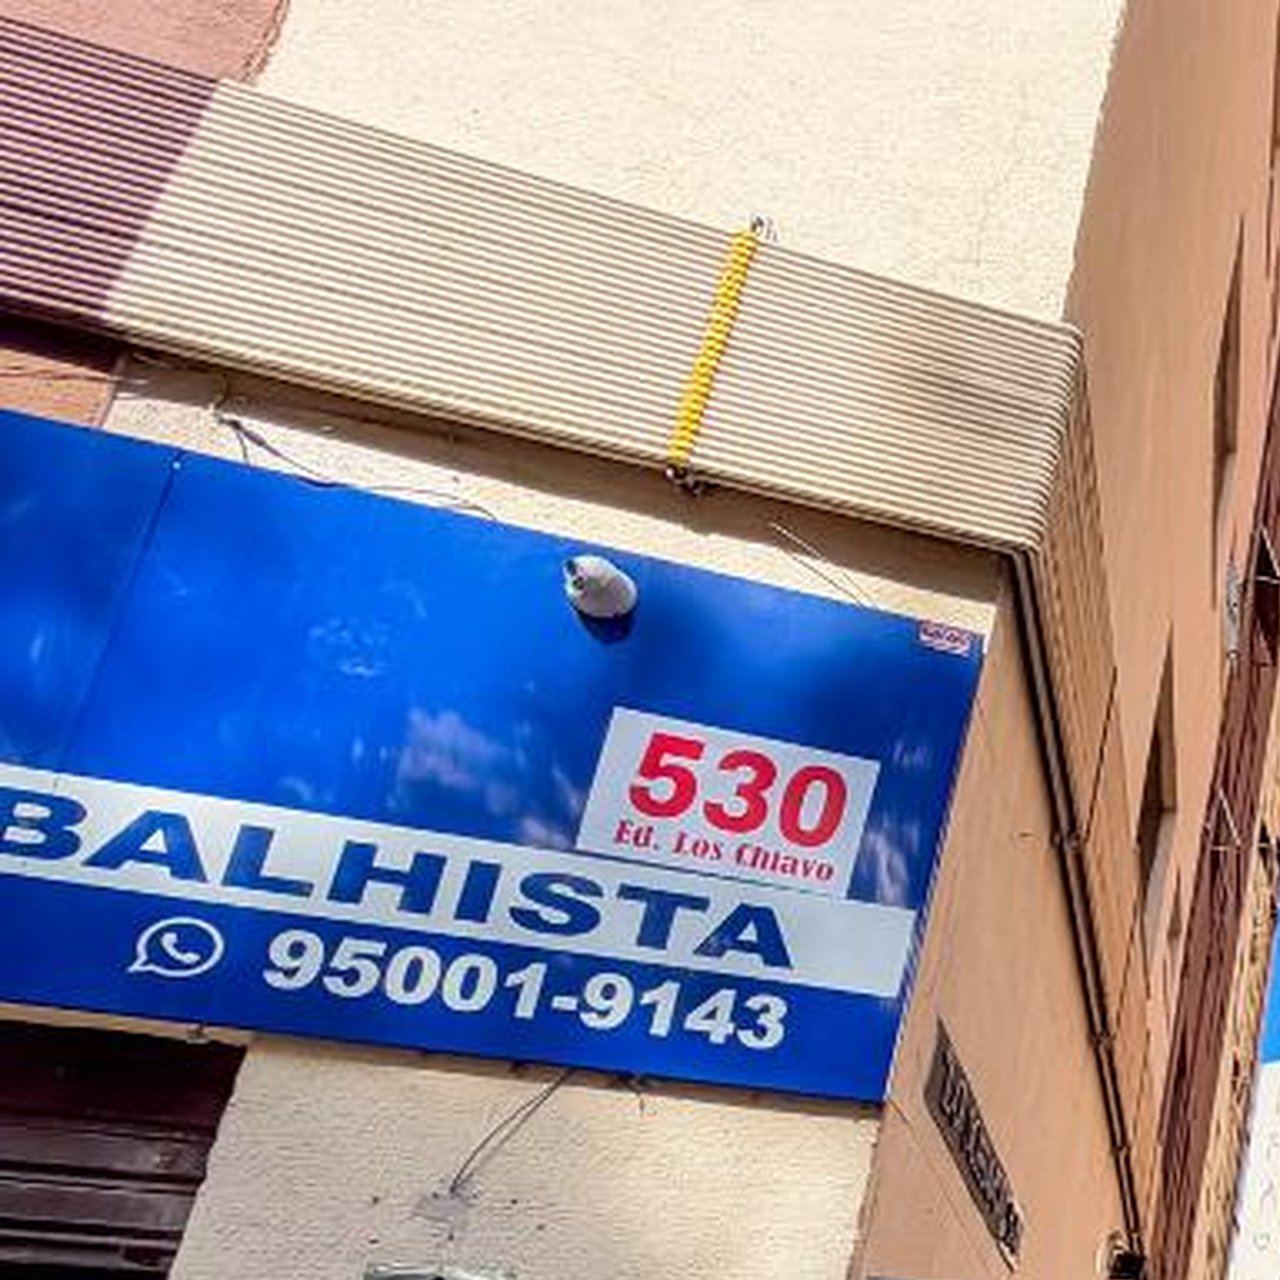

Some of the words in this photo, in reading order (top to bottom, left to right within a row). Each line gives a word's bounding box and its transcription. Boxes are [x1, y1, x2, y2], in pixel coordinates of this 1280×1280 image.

[613, 820, 659, 850] Ed.
[672, 831, 722, 861] Los
[629, 732, 847, 847] 530
[0, 787, 793, 969] BALHISTA
[262, 929, 789, 1050] 95001-9143
